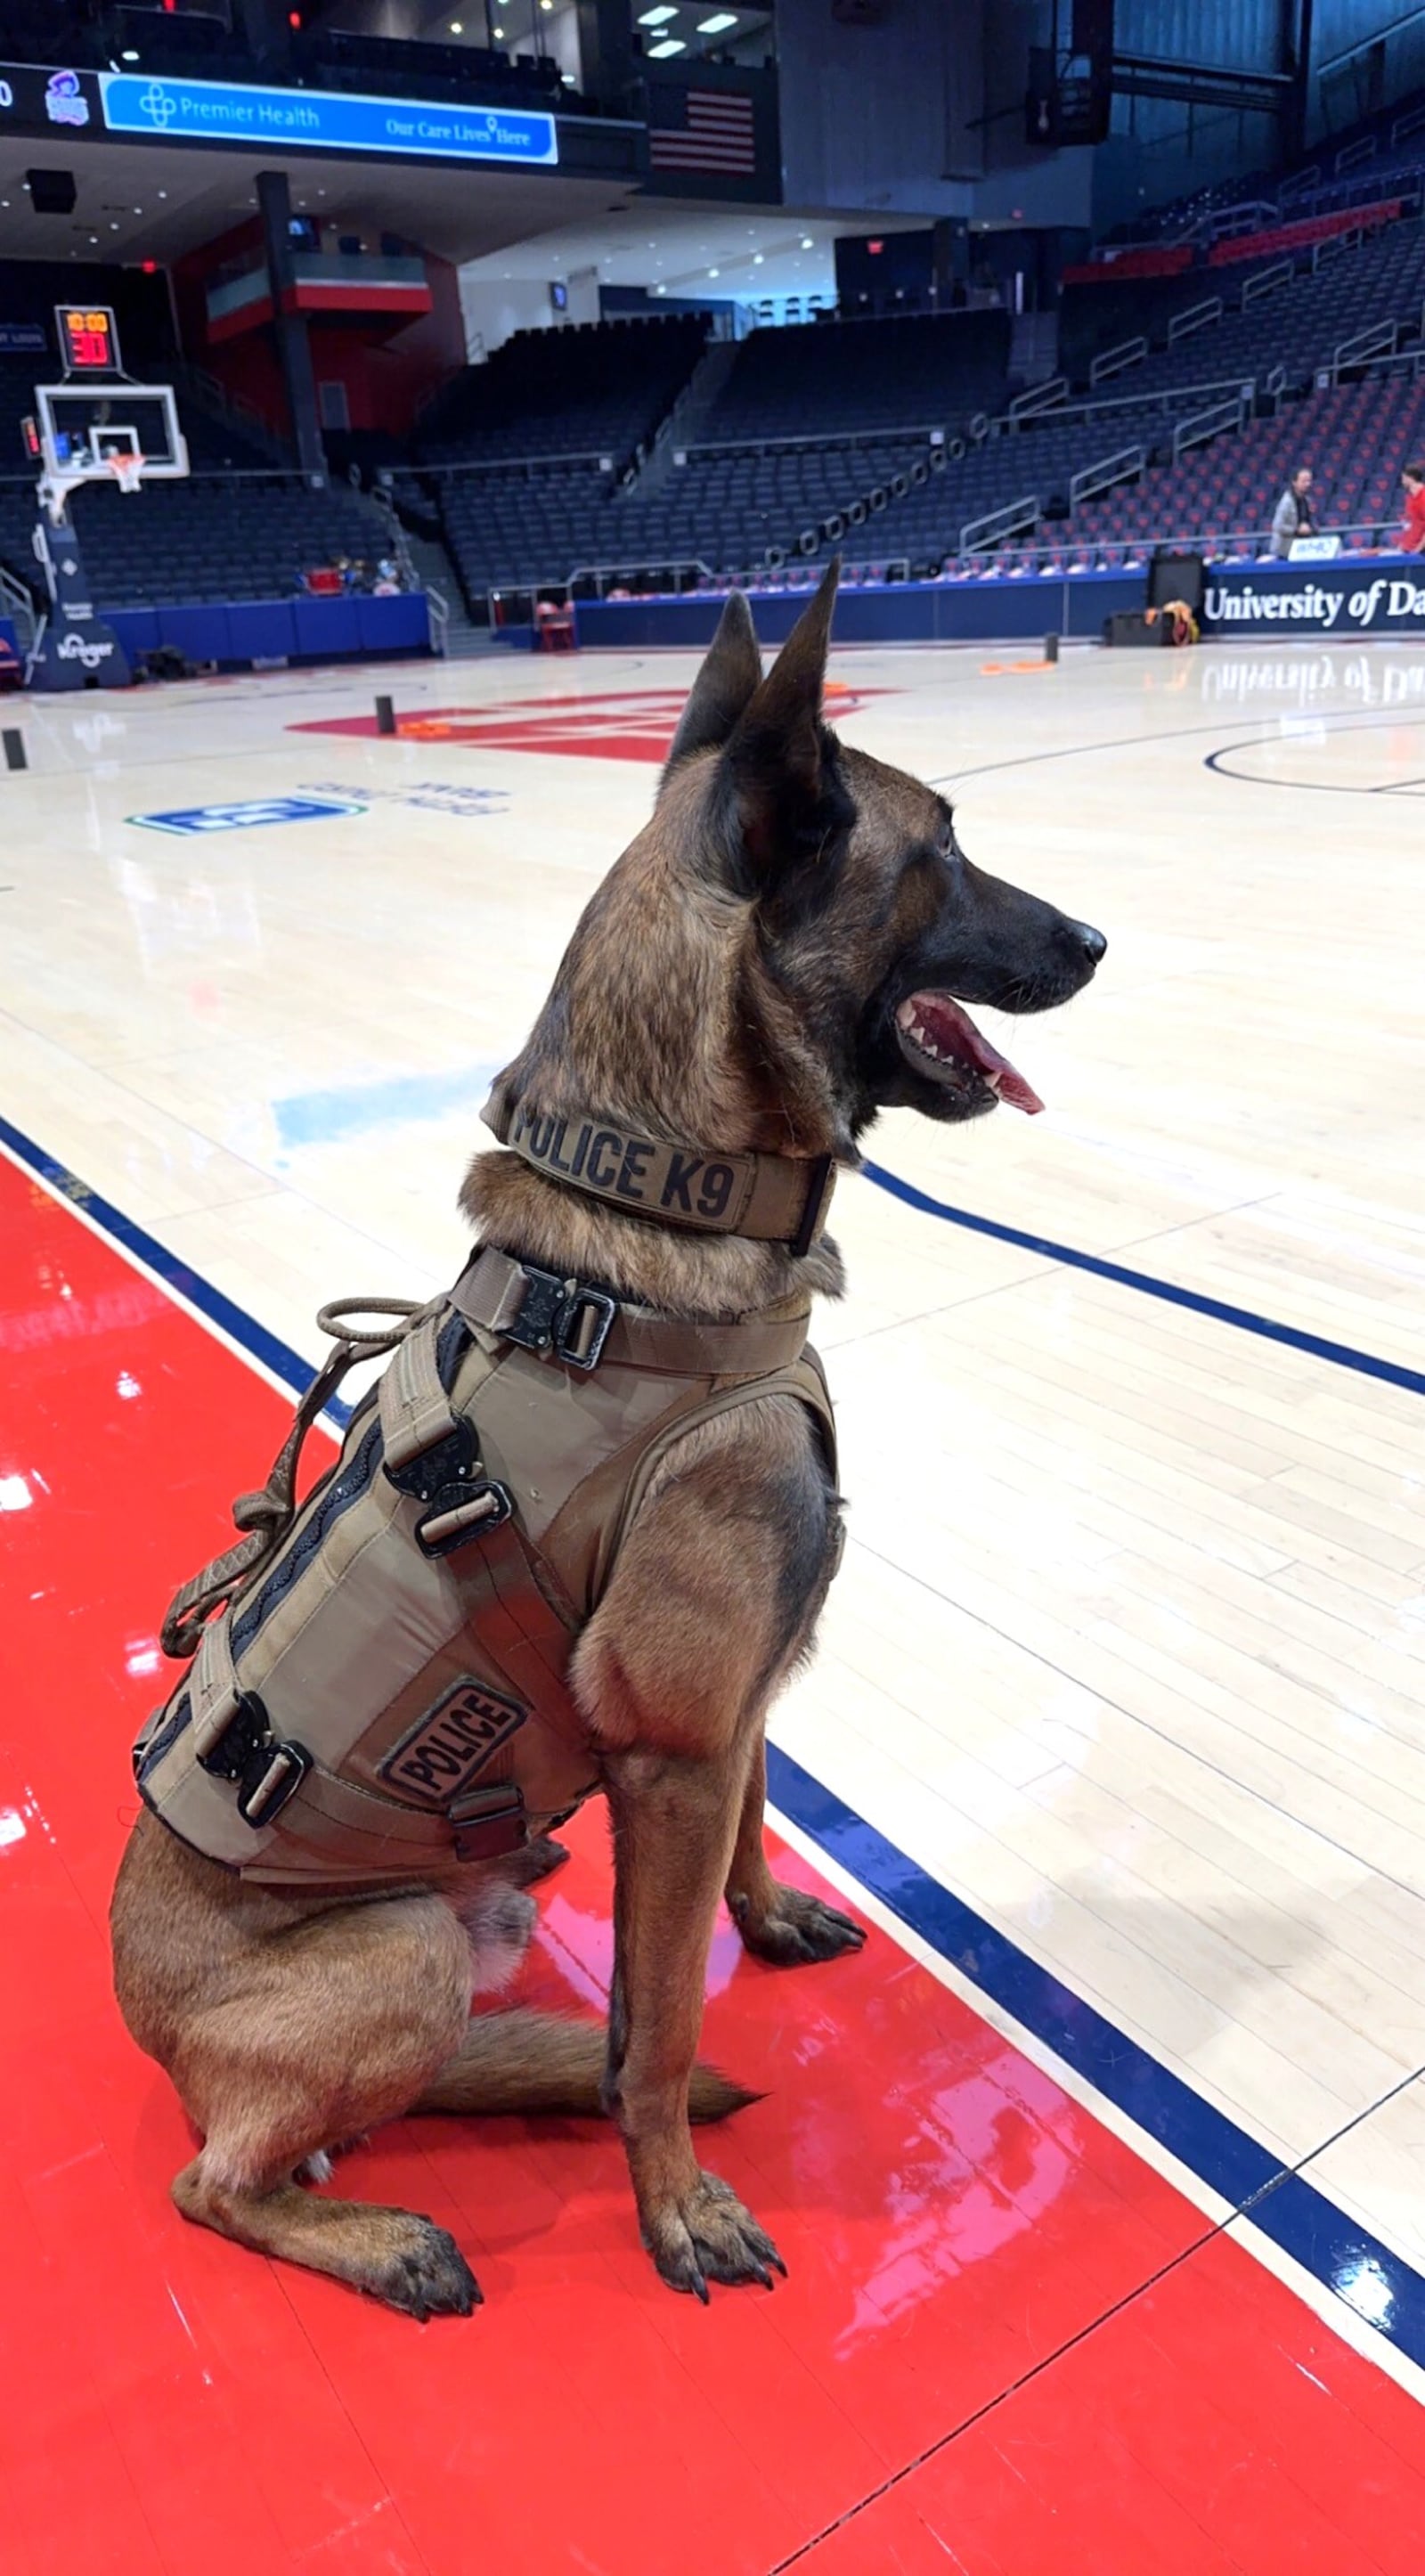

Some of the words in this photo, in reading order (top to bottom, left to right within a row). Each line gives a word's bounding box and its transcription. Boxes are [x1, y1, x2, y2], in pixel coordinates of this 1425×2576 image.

[181, 97, 254, 122] Premier
[259, 104, 321, 128] Health
[386, 118, 414, 136] Our
[418, 122, 452, 140] Care
[454, 124, 492, 143] Lives
[497, 129, 531, 146] Here
[71, 332, 108, 363] 30
[1204, 583, 1344, 627] University
[1348, 579, 1387, 626] of
[1388, 581, 1425, 616] Da
[660, 1152, 735, 1218] K9
[399, 1693, 512, 1791] POLICE
